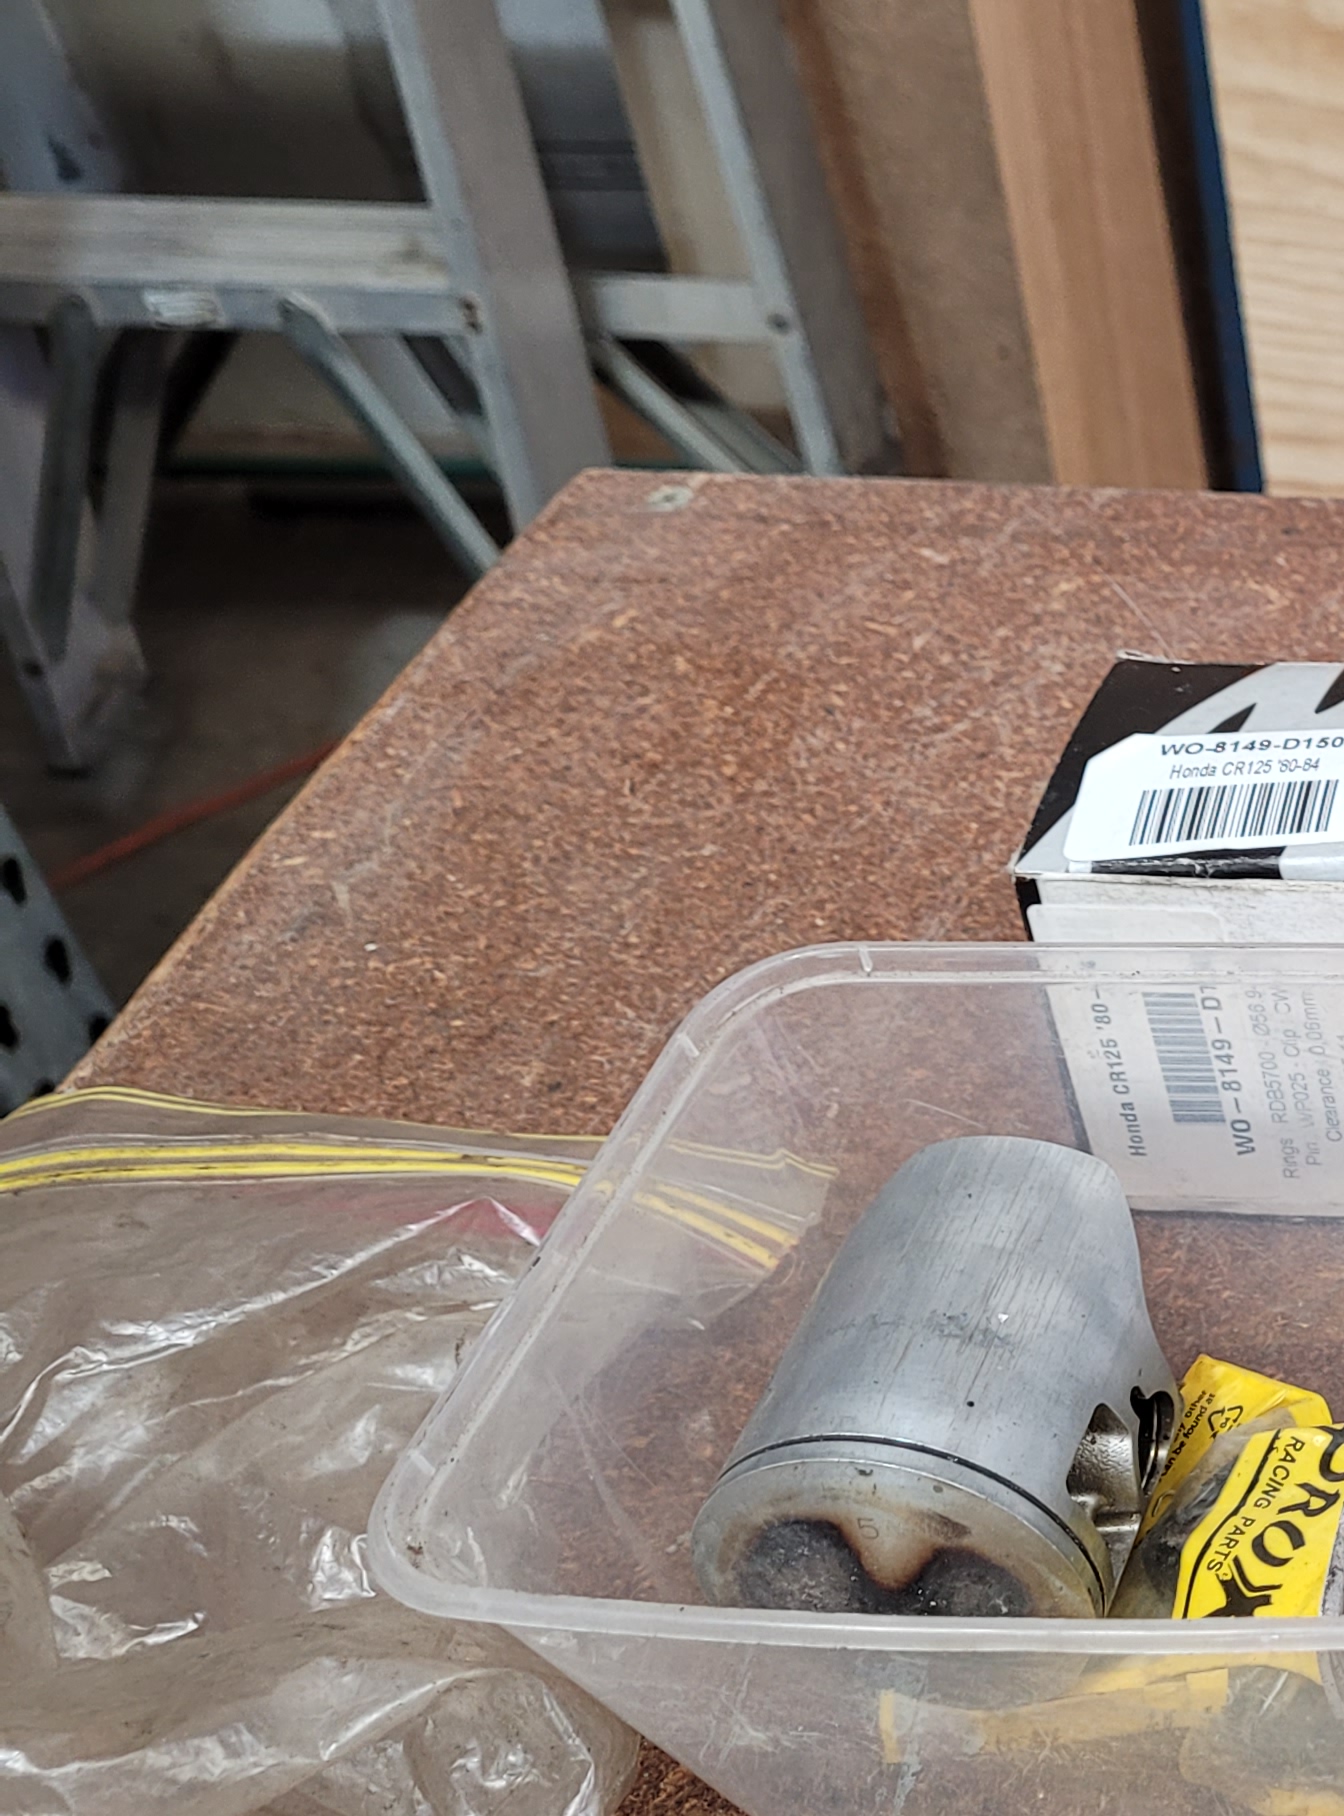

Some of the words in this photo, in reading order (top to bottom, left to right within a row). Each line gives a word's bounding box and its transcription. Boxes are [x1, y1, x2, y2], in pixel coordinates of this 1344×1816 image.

[1161, 736, 1344, 756] WO-8149-D150
[1169, 762, 1216, 780] Honda
[1222, 759, 1272, 776] CR125
[1100, 1038, 1130, 1095] CR125
[1118, 1102, 1147, 1157] Honda
[1305, 1142, 1322, 1167] Pin
[1282, 1137, 1300, 1179] Rings
[1172, 1440, 1187, 1455] be
[1183, 1405, 1207, 1439] found
[1253, 1436, 1306, 1510] RACING
[1206, 1516, 1256, 1573] PARTS
